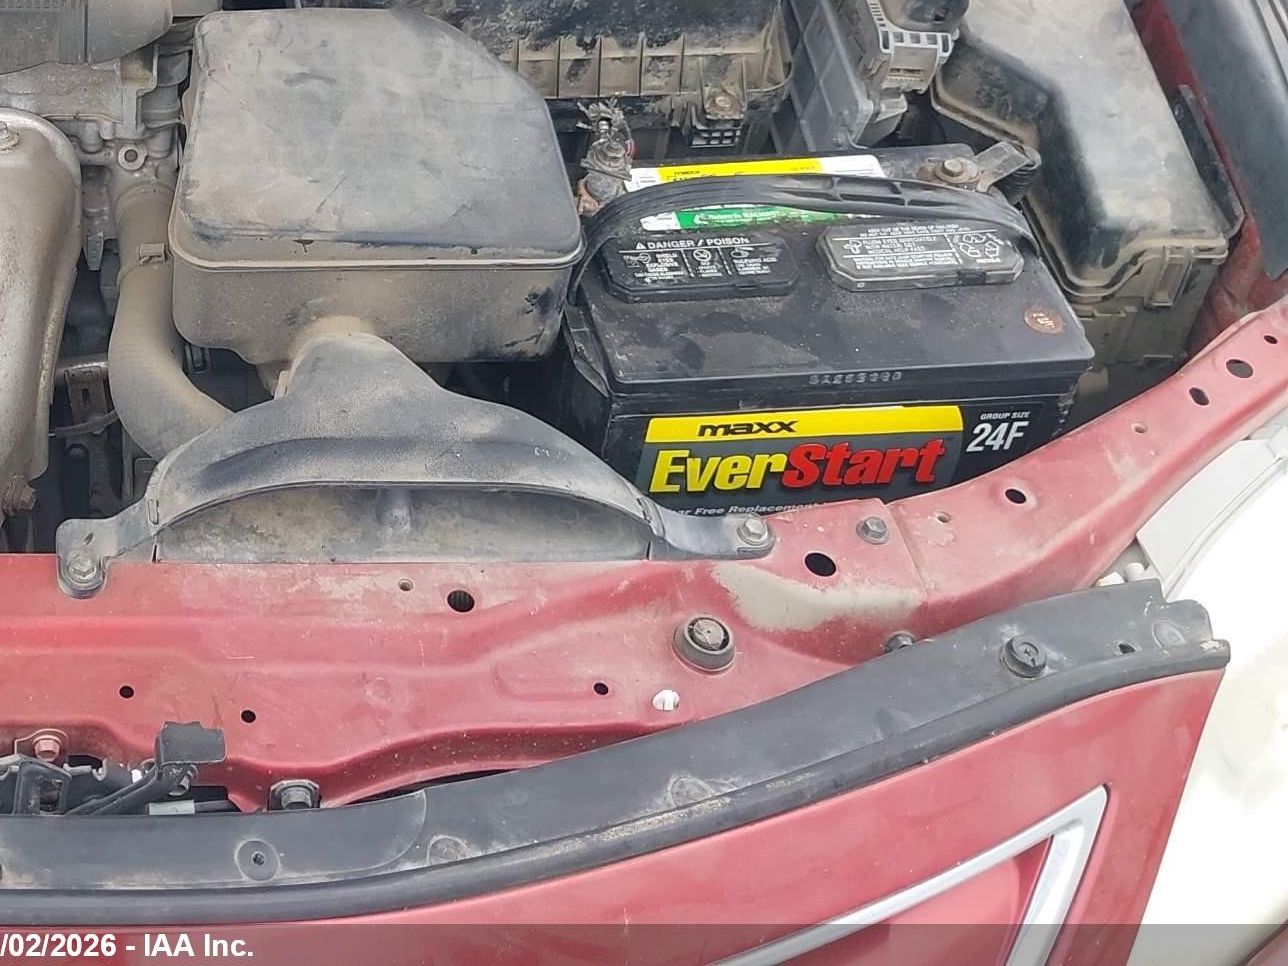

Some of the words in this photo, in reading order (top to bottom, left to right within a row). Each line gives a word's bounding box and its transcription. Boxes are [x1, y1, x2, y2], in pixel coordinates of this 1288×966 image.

[647, 240, 695, 249] DANGER
[706, 237, 750, 246] POISON
[980, 412, 1010, 420] GROUP
[1011, 411, 1031, 419] SIZE
[697, 420, 799, 437] maxx
[965, 421, 1030, 452] 24F
[648, 438, 946, 493] EverStart
[694, 507, 725, 515] Free
